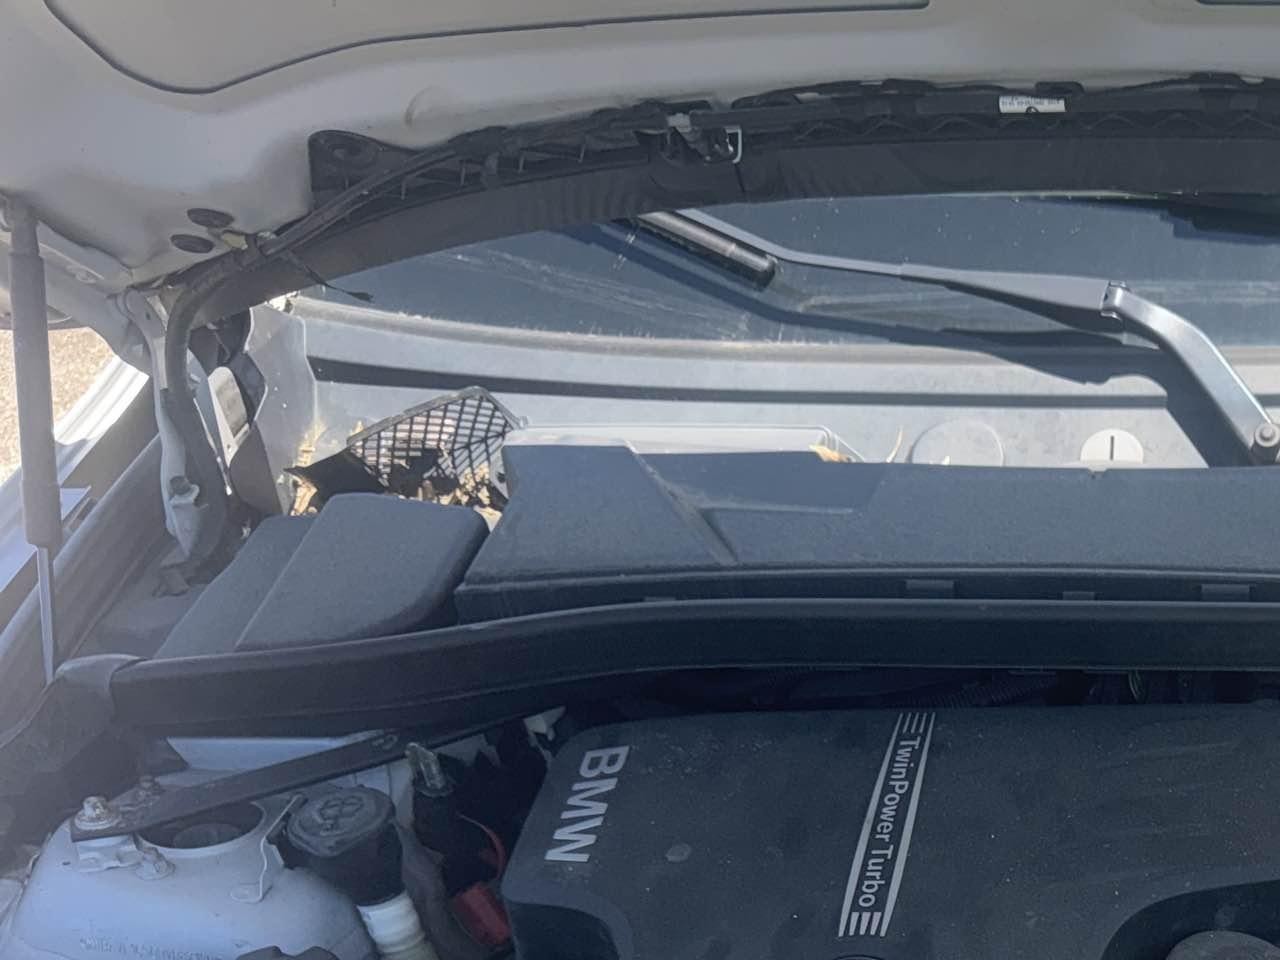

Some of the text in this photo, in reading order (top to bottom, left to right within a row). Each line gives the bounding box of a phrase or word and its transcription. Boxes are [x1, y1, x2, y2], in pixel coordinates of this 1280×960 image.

[544, 744, 631, 864] BMW
[858, 736, 921, 909] TwinPower Turbo
